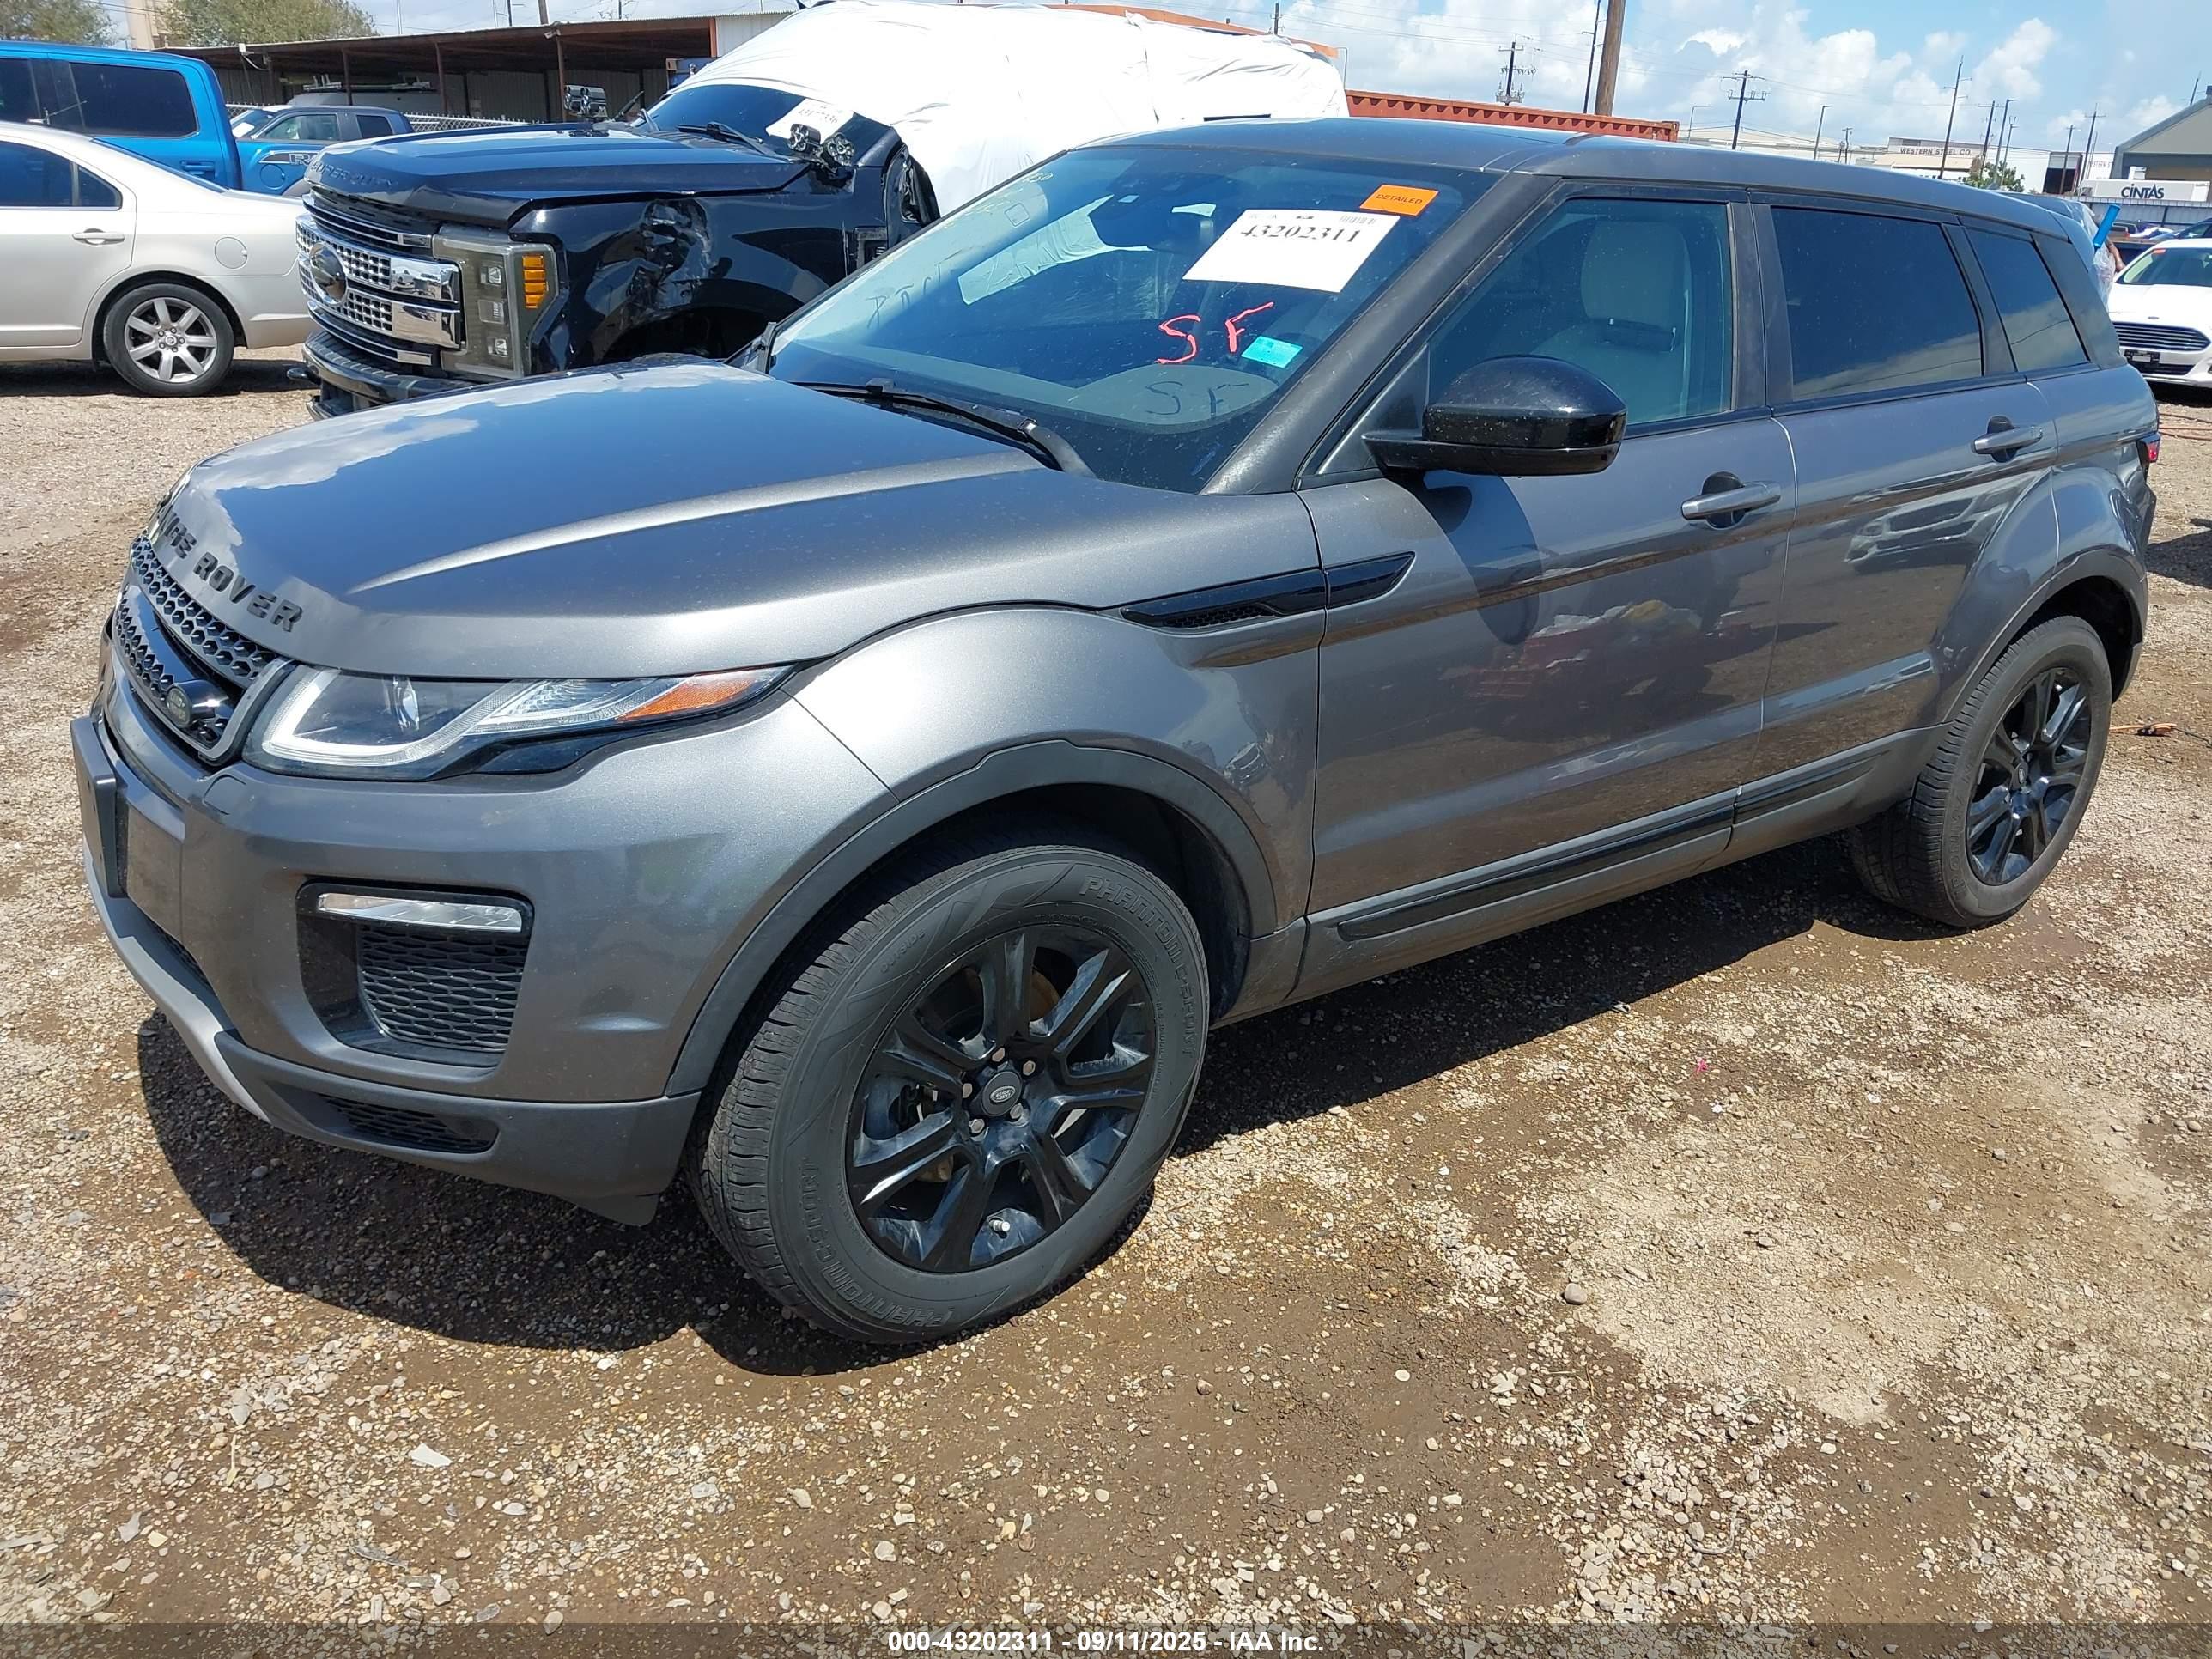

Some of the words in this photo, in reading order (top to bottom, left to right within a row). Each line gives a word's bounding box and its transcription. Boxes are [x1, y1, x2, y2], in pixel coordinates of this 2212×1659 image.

[1900, 147, 1933, 155] WESTERN
[1376, 193, 1423, 205] DETAILED
[1240, 224, 1361, 243] 43202311
[192, 551, 303, 633] ROVER
[1079, 875, 1183, 963] PHANTOM
[880, 928, 926, 973] OUTSIDE
[822, 1261, 955, 1328] PHANTOM
